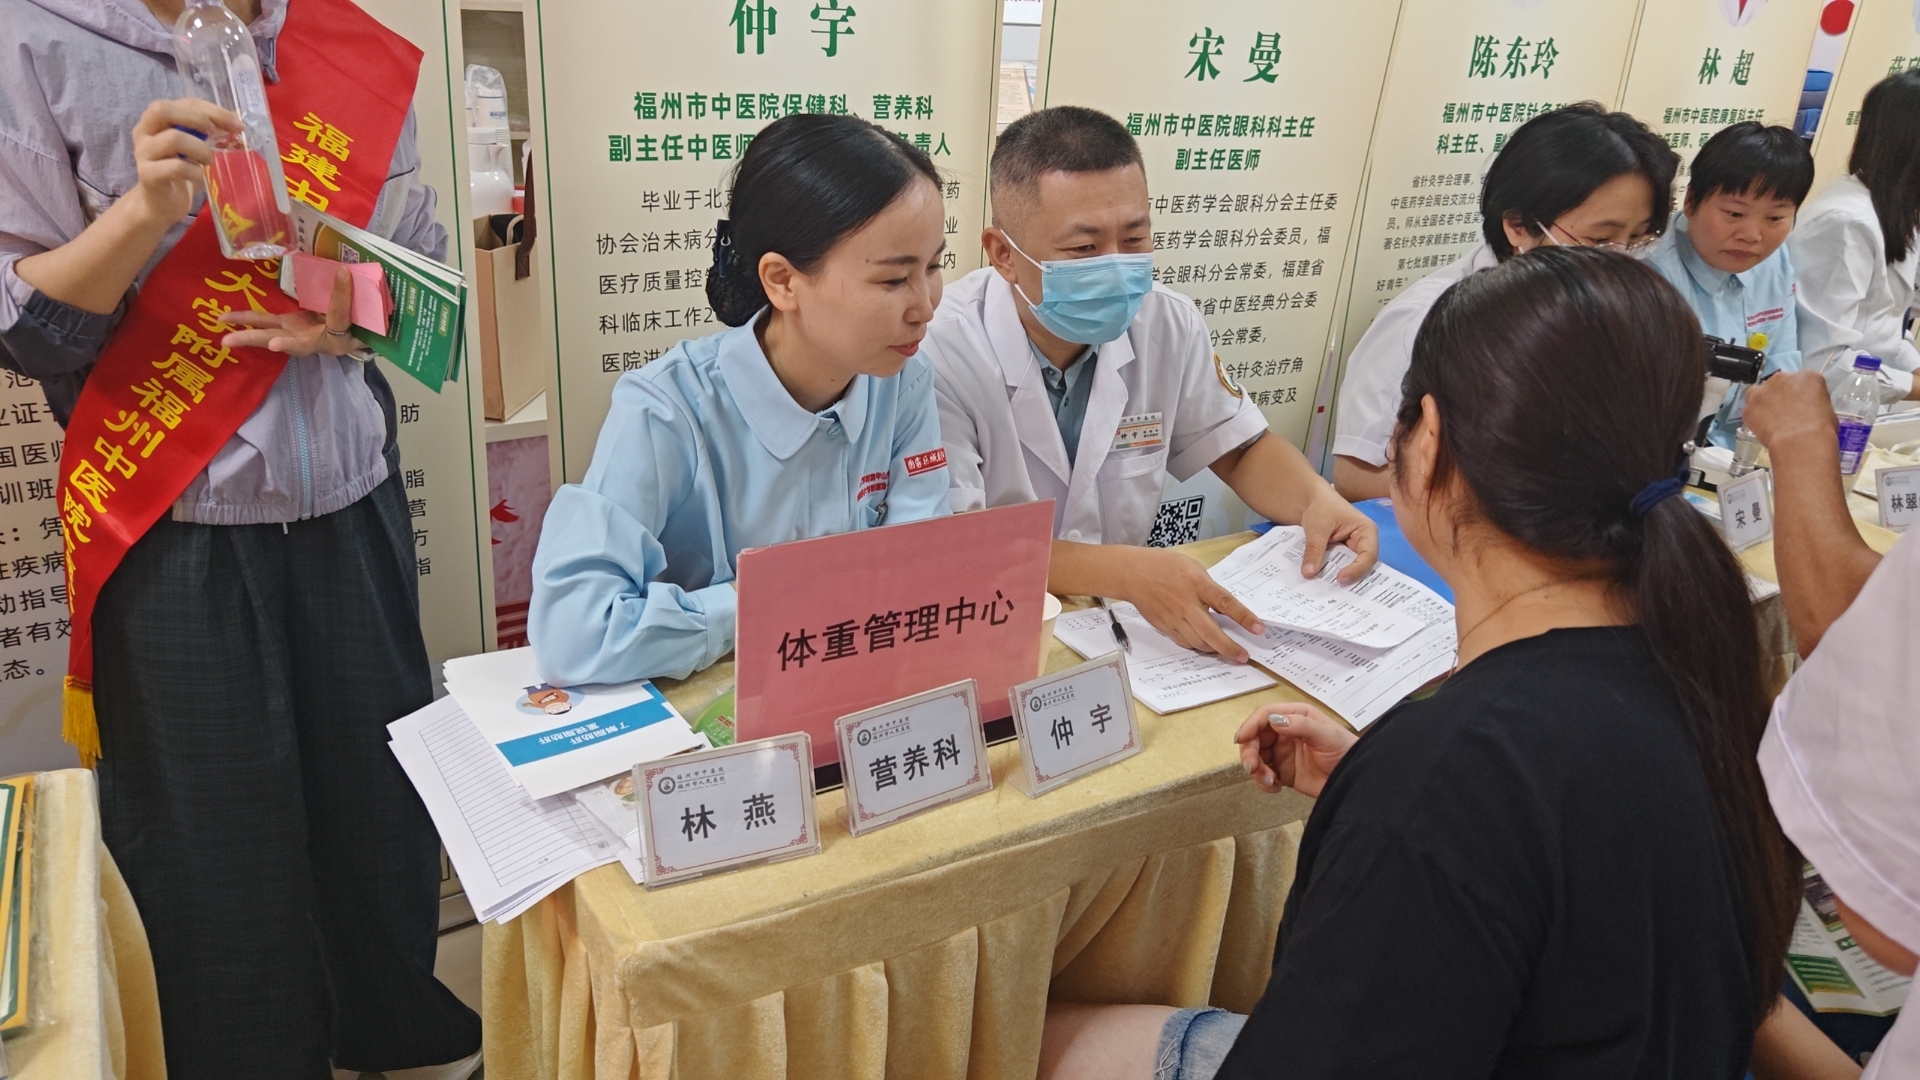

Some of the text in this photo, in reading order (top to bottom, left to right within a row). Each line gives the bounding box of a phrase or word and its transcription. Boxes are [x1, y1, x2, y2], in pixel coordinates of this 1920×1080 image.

[729, 0, 857, 57] 仲宇
[1185, 27, 1283, 84] 宋曼
[1468, 35, 1560, 79] 陈东玲
[1698, 47, 1754, 86] 林超
[1126, 112, 1315, 138] 福州市中医院眼科科主任
[1175, 148, 1261, 171] 副主任医师
[600, 267, 713, 295] 医疗质量控
[1891, 492, 1920, 513] 林翠
[776, 589, 1015, 672] 体重管理中心
[1050, 703, 1113, 750] 仲宇
[869, 733, 961, 792] 营养科
[680, 792, 777, 842] 林燕
